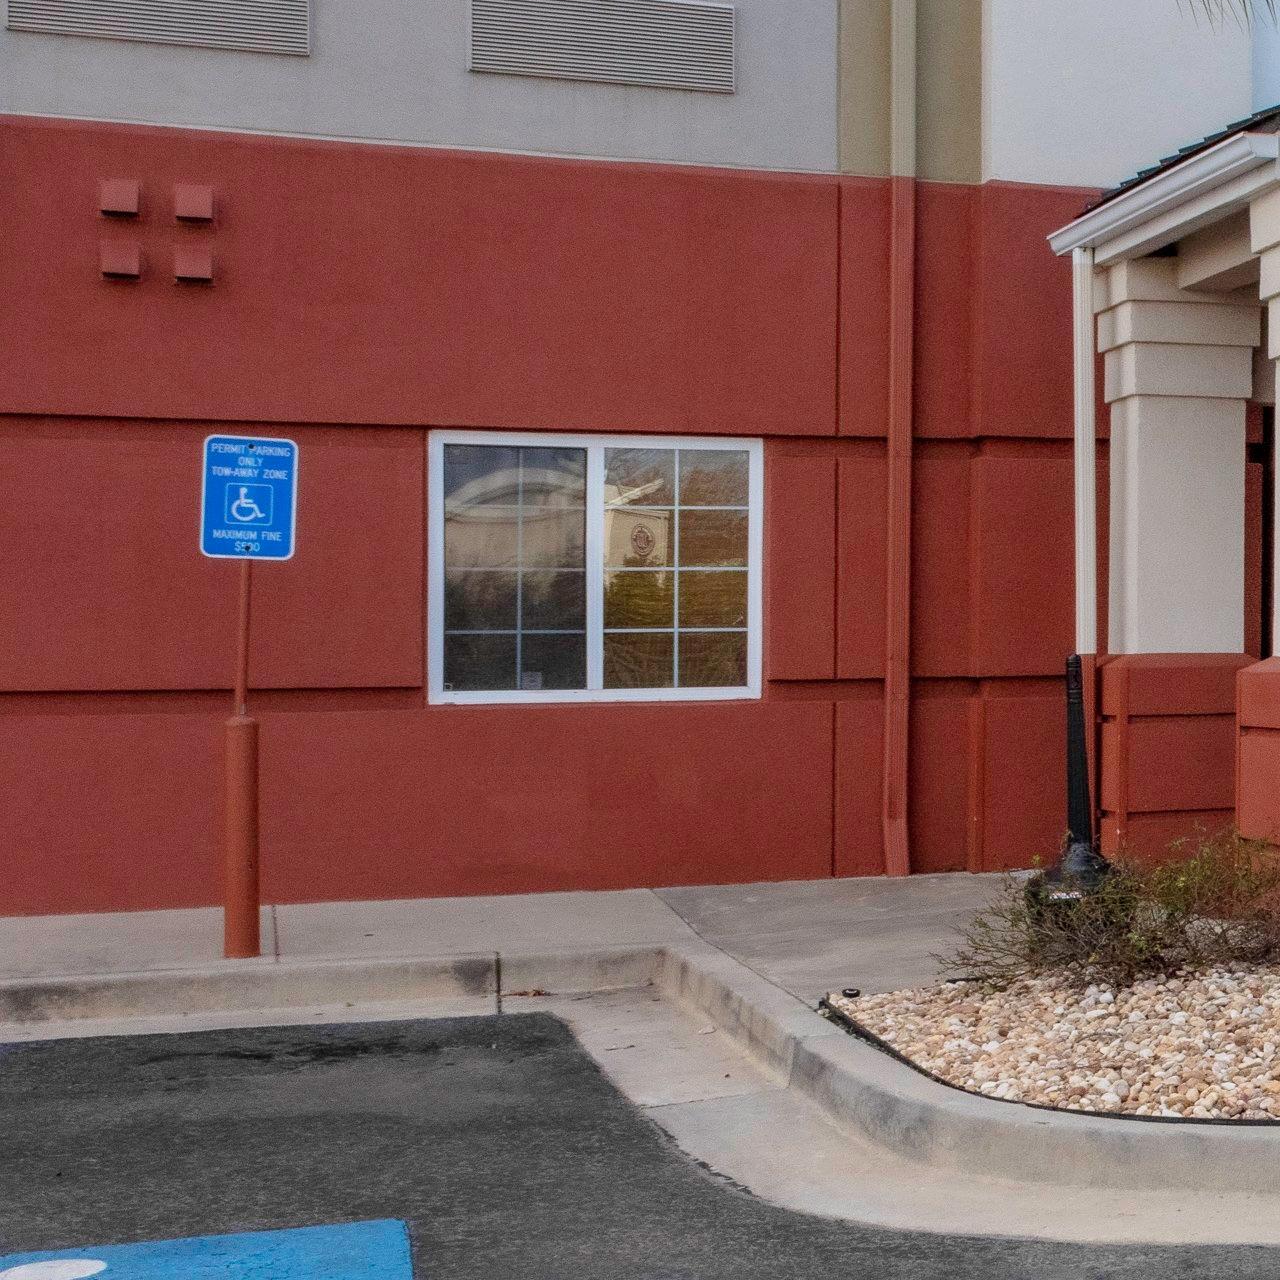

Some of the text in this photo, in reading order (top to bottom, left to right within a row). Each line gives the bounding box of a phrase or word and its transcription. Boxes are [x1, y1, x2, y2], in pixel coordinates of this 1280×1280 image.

[211, 443, 291, 457] PERMIT ARKING
[238, 457, 264, 467] ONLY
[212, 466, 288, 480] TOW-AWAY ZONE
[213, 529, 282, 542] MAXIMUM FINE
